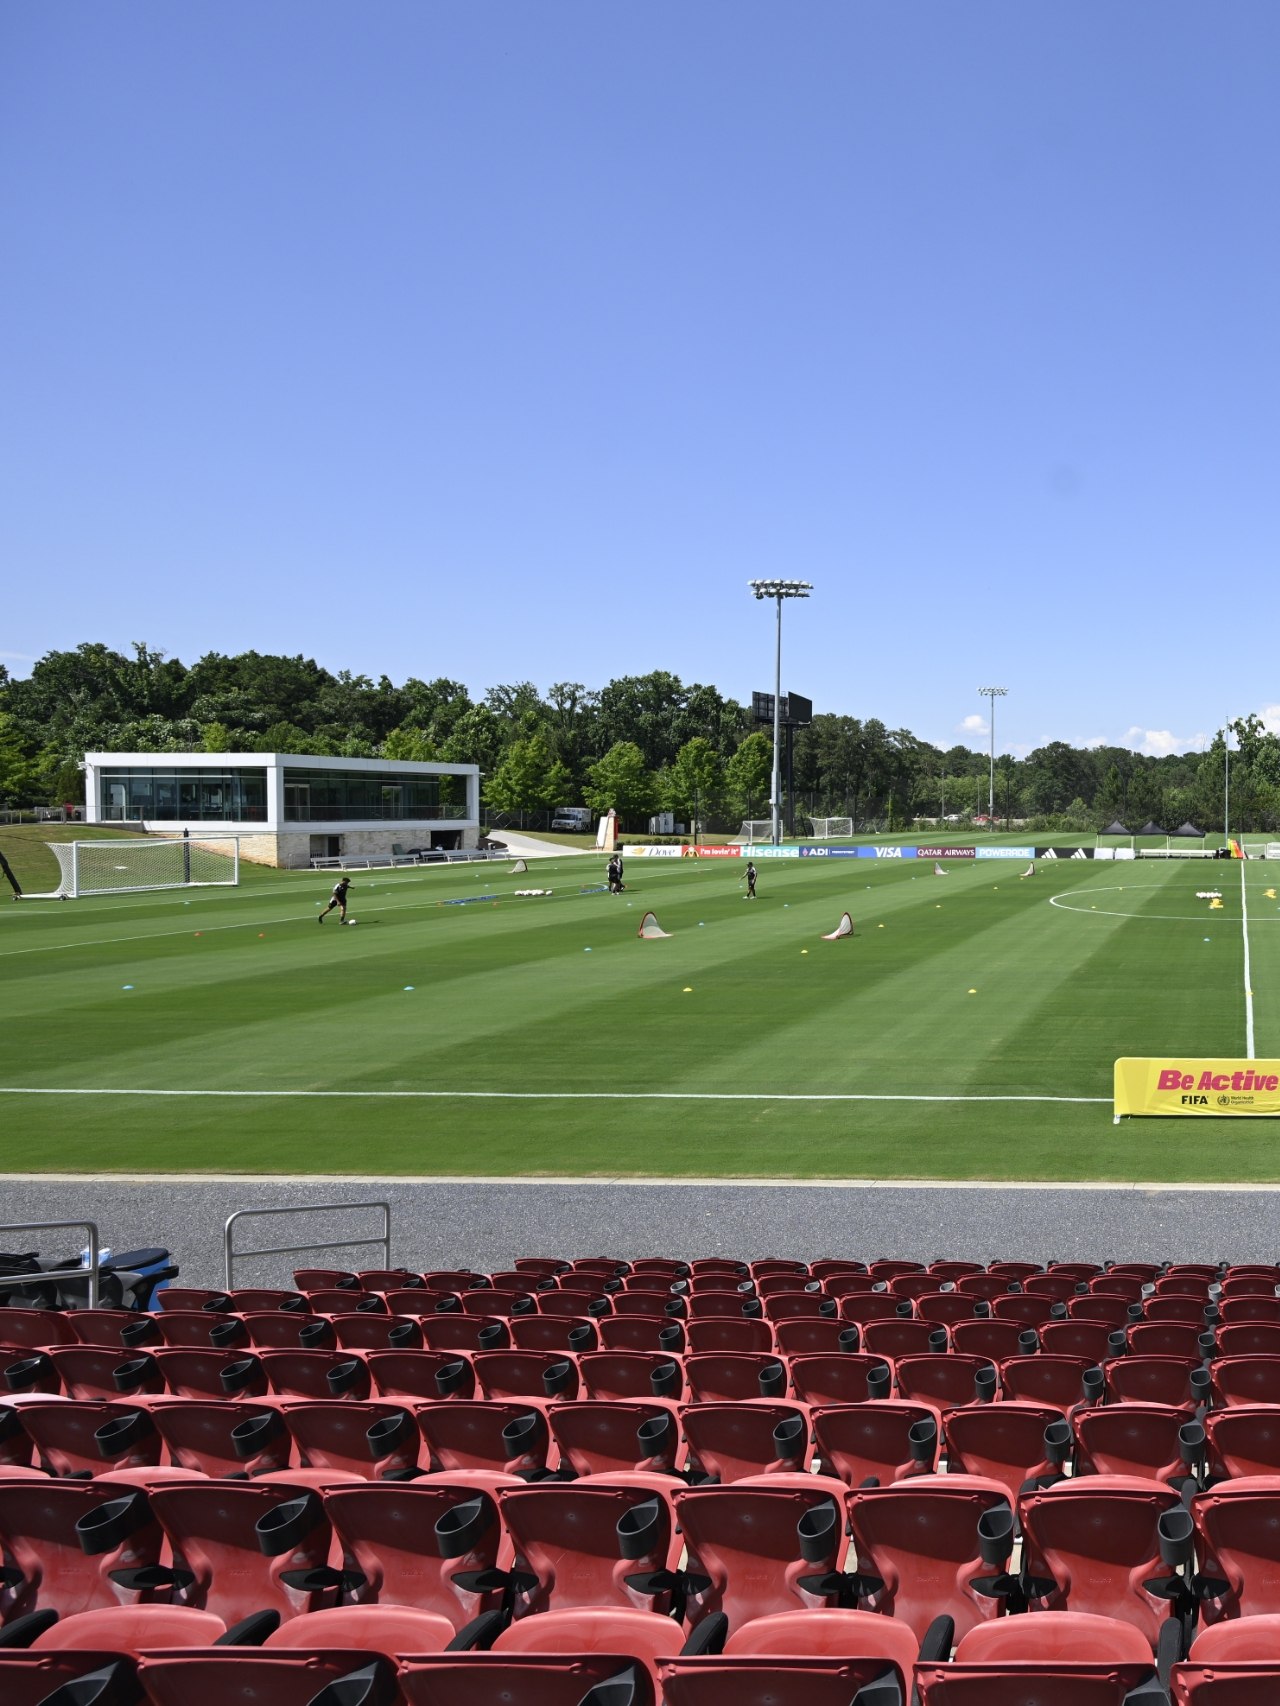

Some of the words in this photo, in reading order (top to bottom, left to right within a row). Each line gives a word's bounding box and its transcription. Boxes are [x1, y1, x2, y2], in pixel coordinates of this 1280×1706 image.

[649, 847, 675, 857] Dove
[740, 846, 799, 857] Hisense
[809, 848, 828, 856] ADI
[874, 847, 902, 858] VISA
[917, 849, 942, 857] QATAR
[944, 849, 975, 857] AIRWAYS
[979, 848, 1030, 857] POWERADE
[1157, 1070, 1194, 1091] Be
[1197, 1070, 1278, 1091] Active
[1182, 1095, 1208, 1105] FIFA
